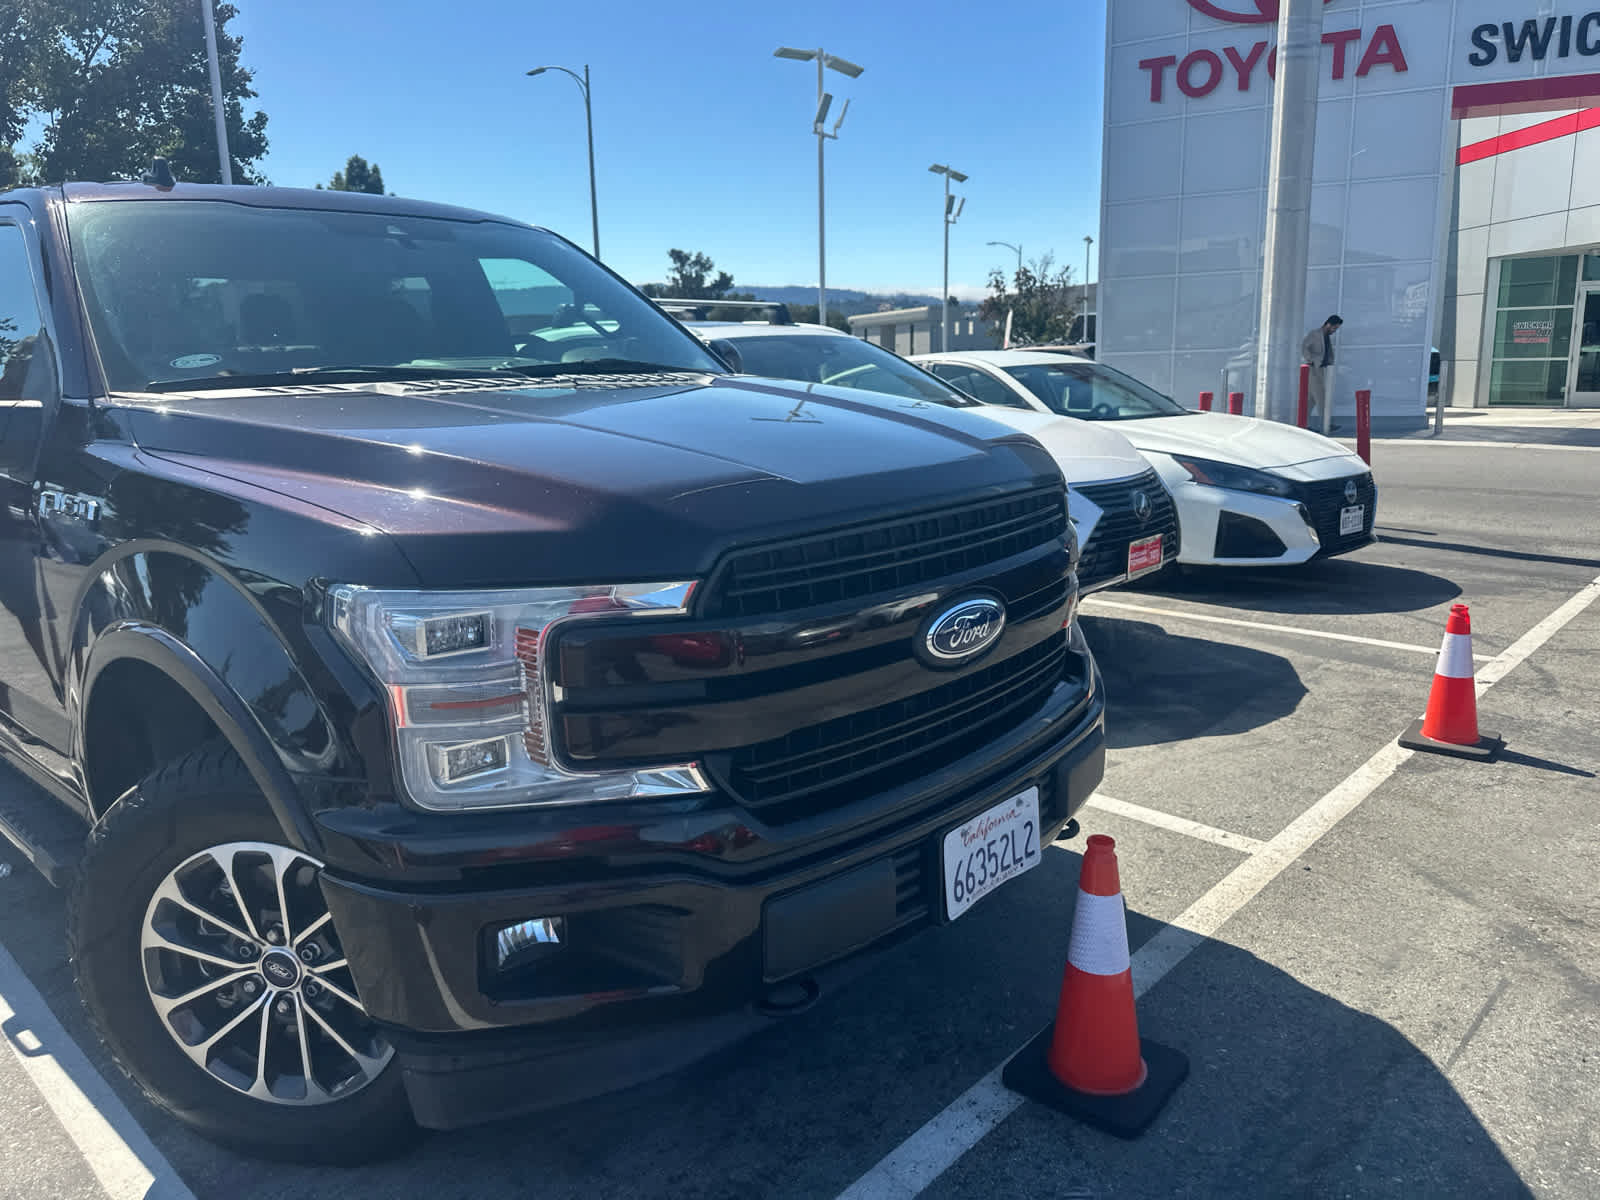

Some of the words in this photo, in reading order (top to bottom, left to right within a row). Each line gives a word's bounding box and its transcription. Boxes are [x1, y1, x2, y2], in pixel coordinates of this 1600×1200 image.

[1139, 24, 1409, 103] TOYTA
[1468, 11, 1600, 67] SWIC
[940, 609, 991, 649] Ford
[962, 808, 1022, 848] California
[953, 820, 1036, 903] 66352L2
